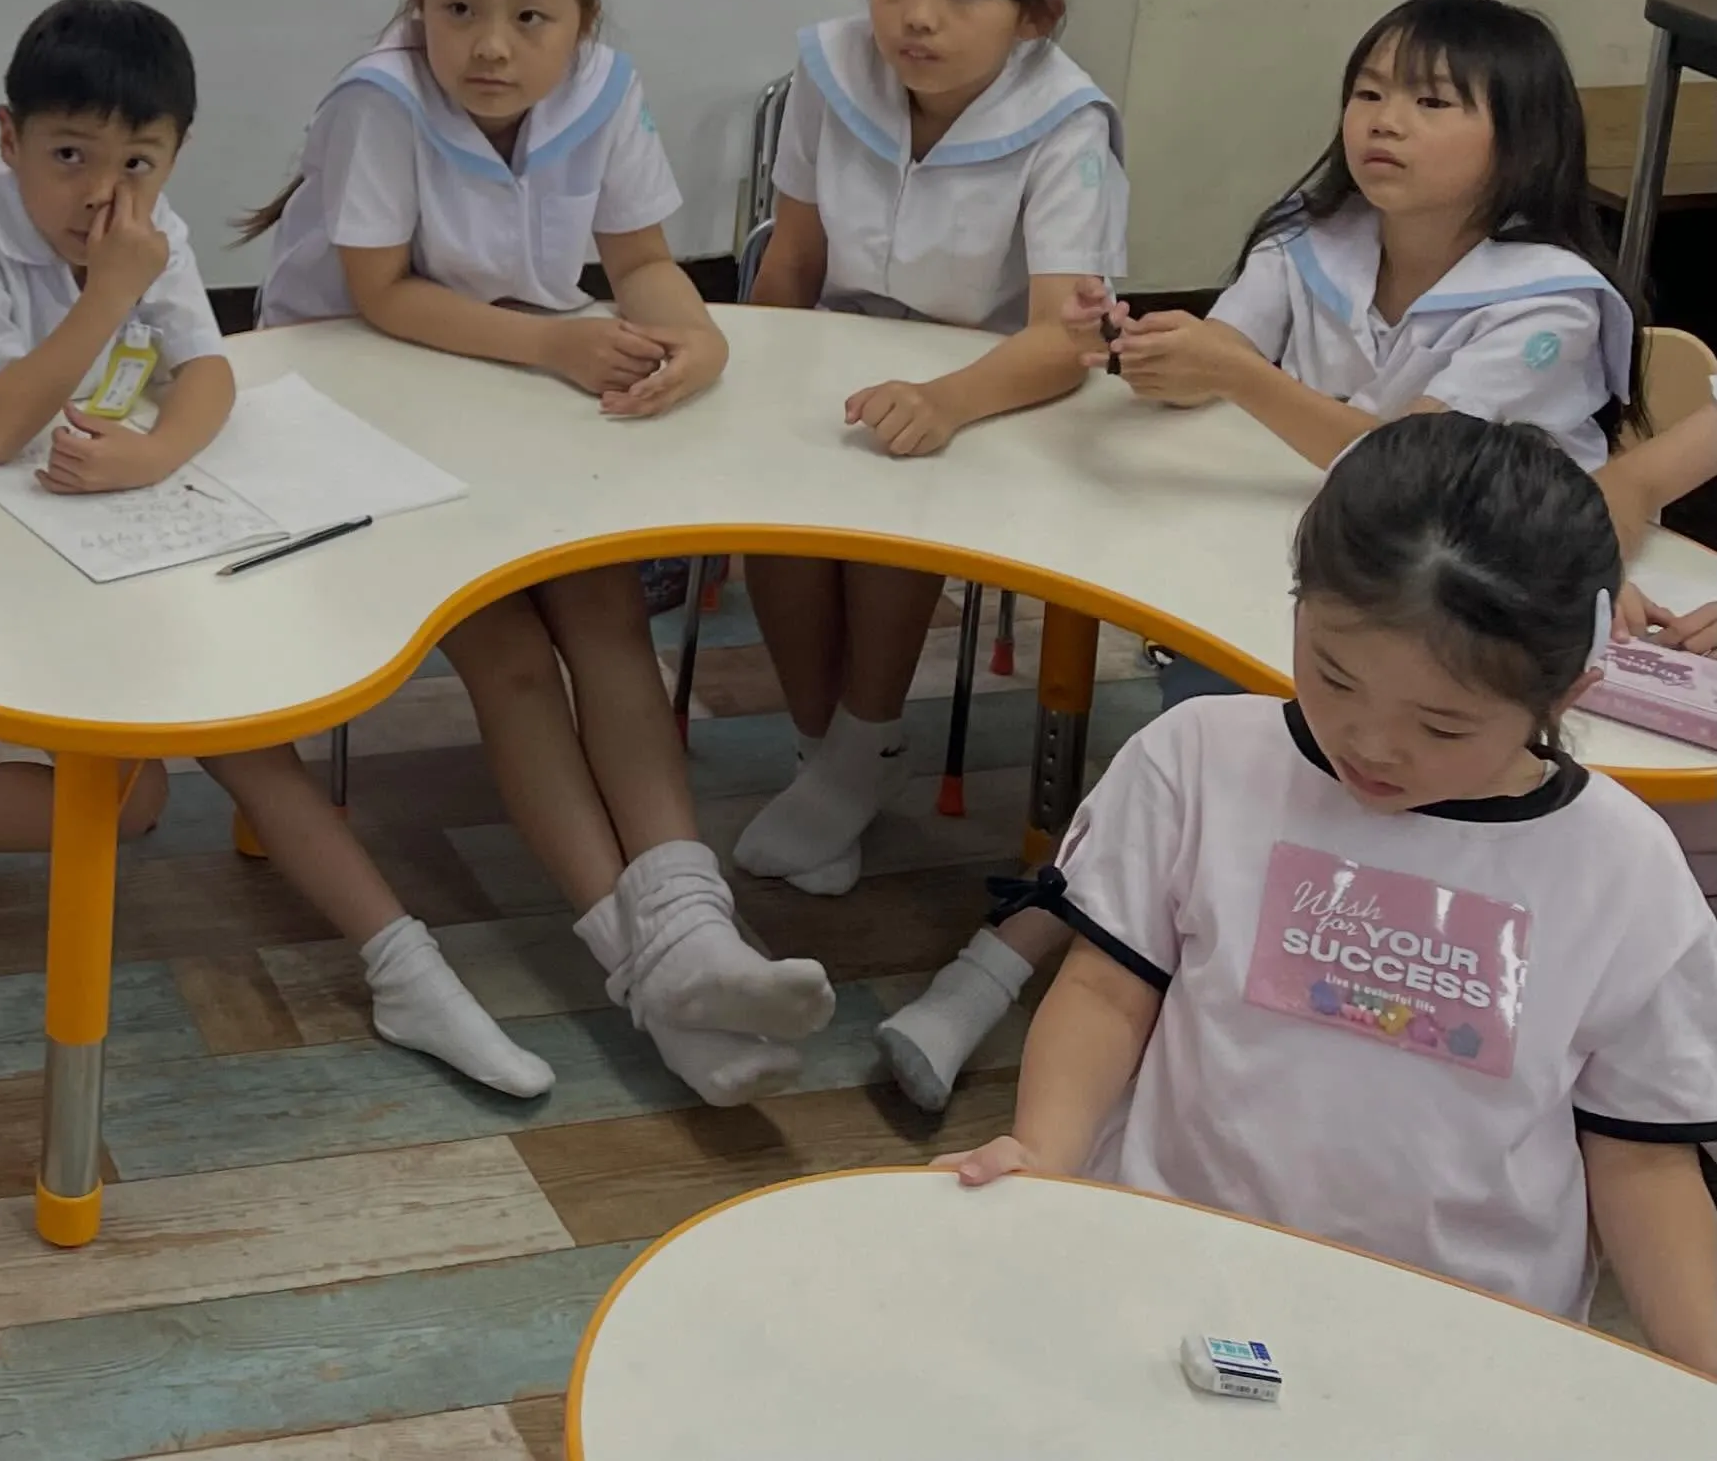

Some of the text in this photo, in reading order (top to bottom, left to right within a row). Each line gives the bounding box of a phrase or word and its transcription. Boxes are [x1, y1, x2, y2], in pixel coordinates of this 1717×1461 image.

[1292, 881, 1383, 920] Wish
[1282, 927, 1491, 1008] SUCCESS
[1315, 912, 1479, 975] for YOUR
